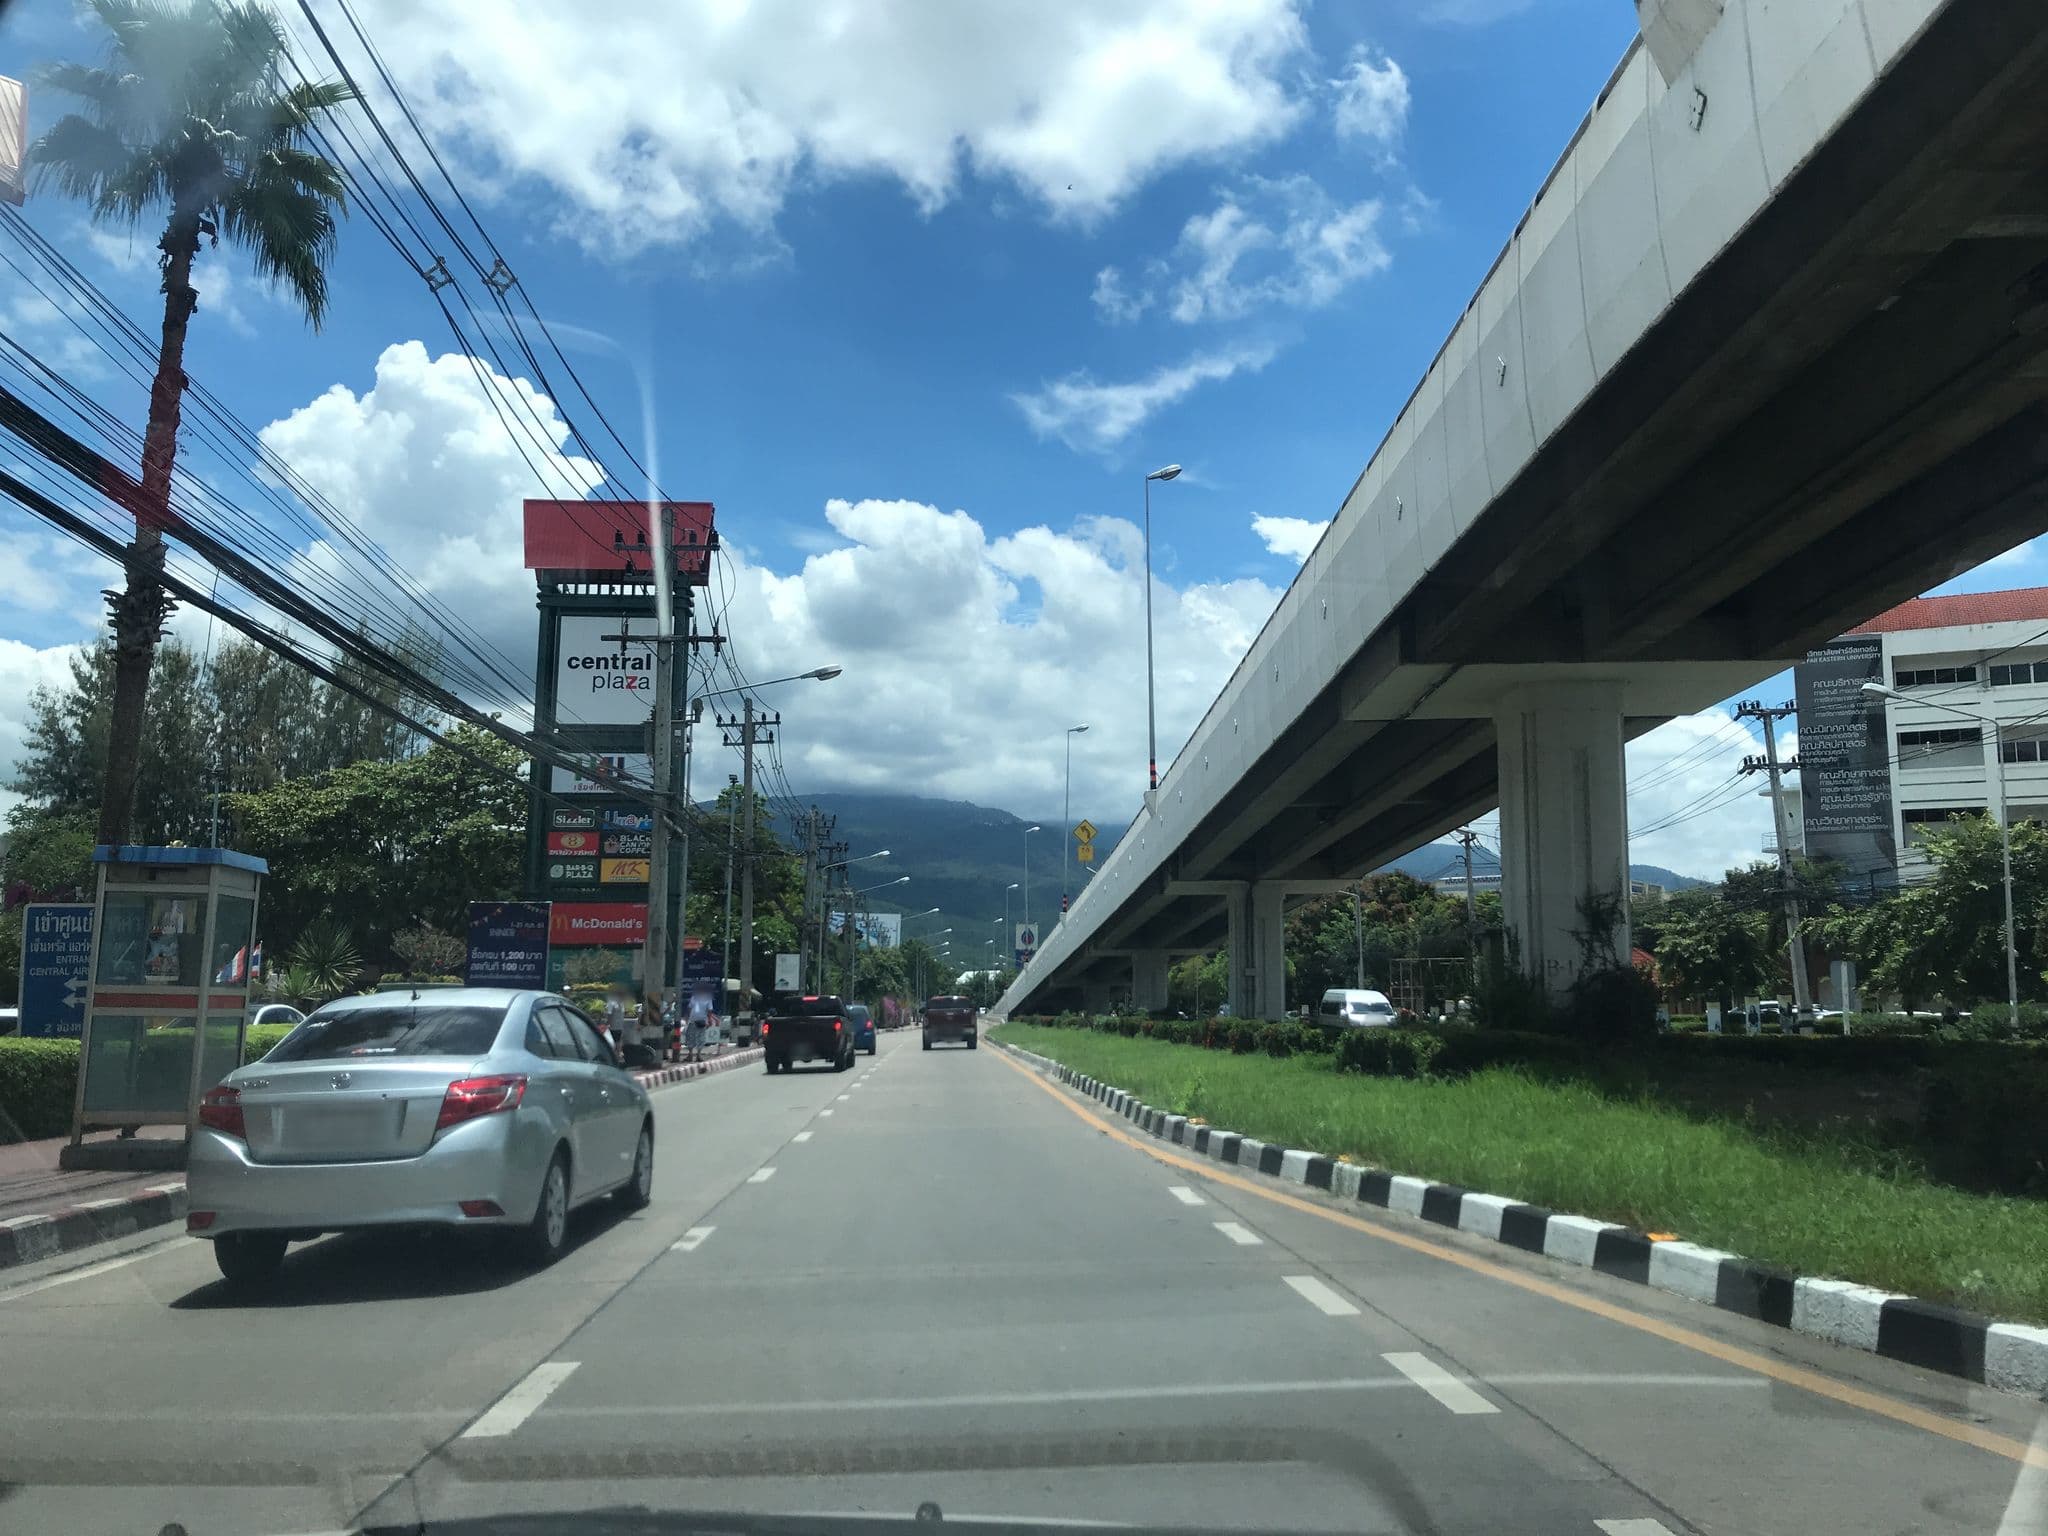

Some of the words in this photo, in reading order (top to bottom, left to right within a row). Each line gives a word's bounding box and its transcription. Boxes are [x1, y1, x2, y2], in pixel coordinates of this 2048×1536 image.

[567, 653, 651, 670] central
[1846, 652, 1881, 661] UNIVERSITY
[592, 672, 651, 693] plaza
[555, 814, 592, 824] Sizzler
[611, 861, 643, 875] MK
[566, 871, 593, 879] PLAZA
[571, 918, 643, 929] McDonald's
[500, 951, 525, 961] 1,200
[501, 962, 518, 971] 100
[29, 967, 70, 977] CENTRAL
